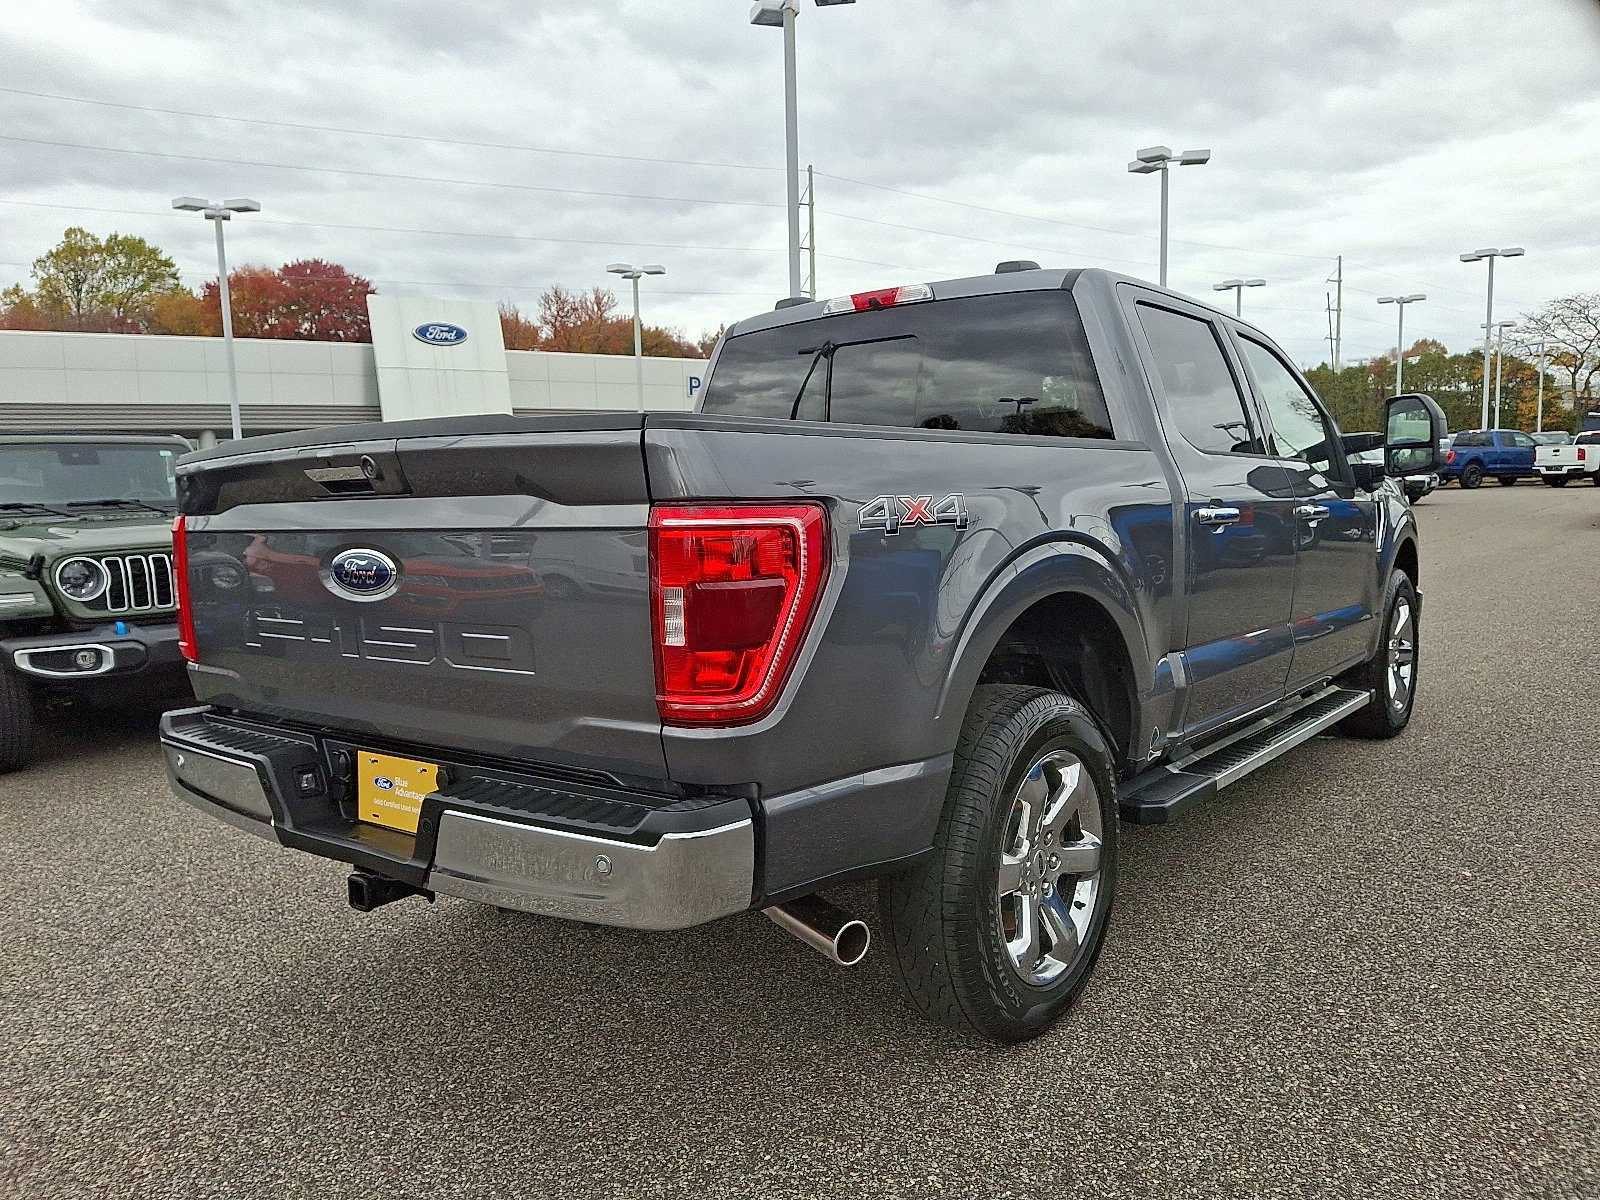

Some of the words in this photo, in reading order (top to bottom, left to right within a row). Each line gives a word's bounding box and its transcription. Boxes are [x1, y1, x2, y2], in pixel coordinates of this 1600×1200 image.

[426, 325, 457, 340] Ford
[342, 558, 378, 585] Ford
[245, 608, 536, 675] F-150
[394, 776, 409, 788] Blue
[394, 786, 425, 803] Advantage
[373, 797, 384, 806] Gold
[383, 799, 401, 810] Certified
[400, 803, 412, 812] Used
